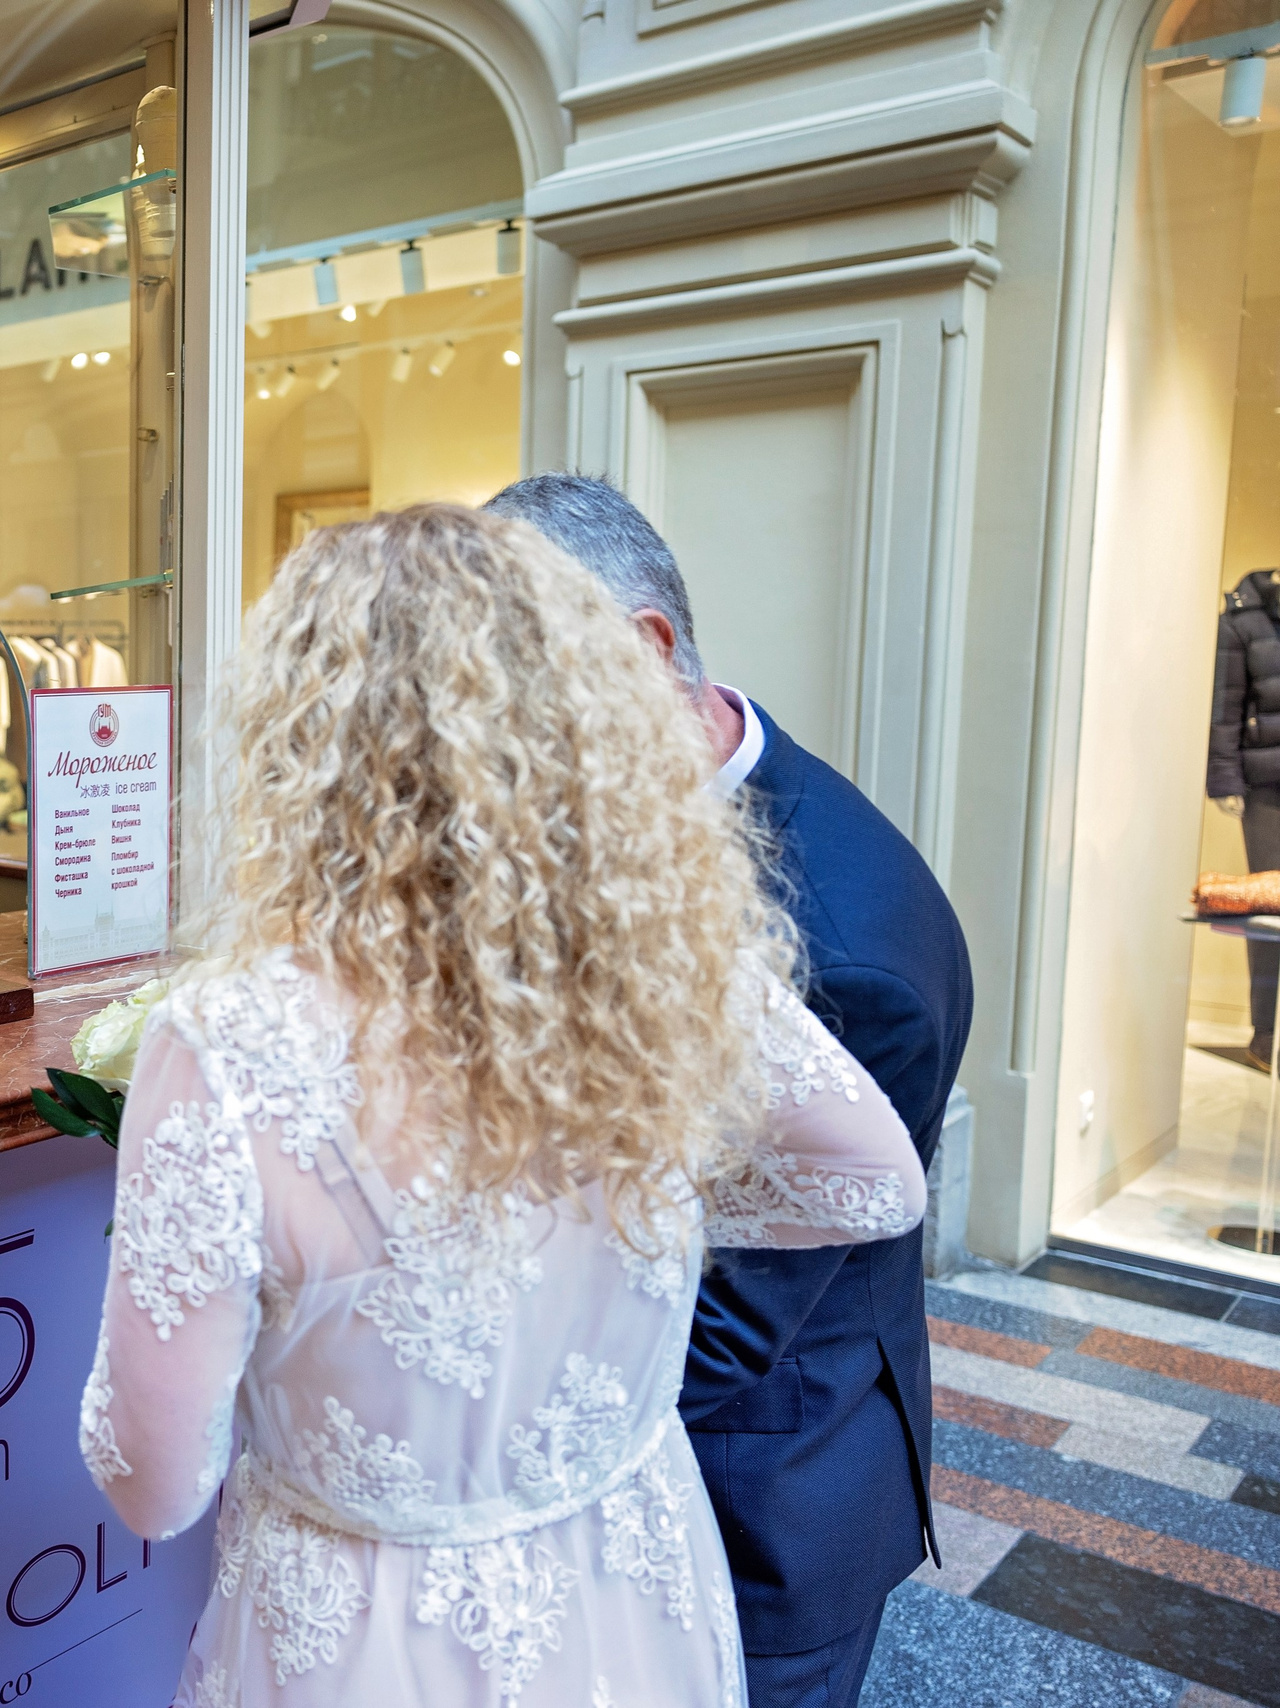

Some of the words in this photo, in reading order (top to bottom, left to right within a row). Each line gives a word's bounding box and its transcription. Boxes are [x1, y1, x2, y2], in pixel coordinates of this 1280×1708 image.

[47, 750, 158, 789] Мороженое
[80, 783, 111, 799] 冰激凌
[115, 782, 128, 795] ice
[130, 781, 157, 793] cream
[54, 808, 90, 819] Ванильное
[111, 803, 141, 814] Шоколад
[111, 818, 142, 830] Клубника
[54, 825, 74, 837] Дыня
[54, 837, 96, 852] Крем-брюле
[111, 834, 132, 845] Вишня
[54, 854, 92, 867] Смородина
[111, 850, 139, 862] Пломбир
[116, 861, 155, 875] шоколадной
[54, 871, 89, 883] Фисташка
[111, 877, 139, 891] крошкой
[54, 887, 82, 900] Черника
